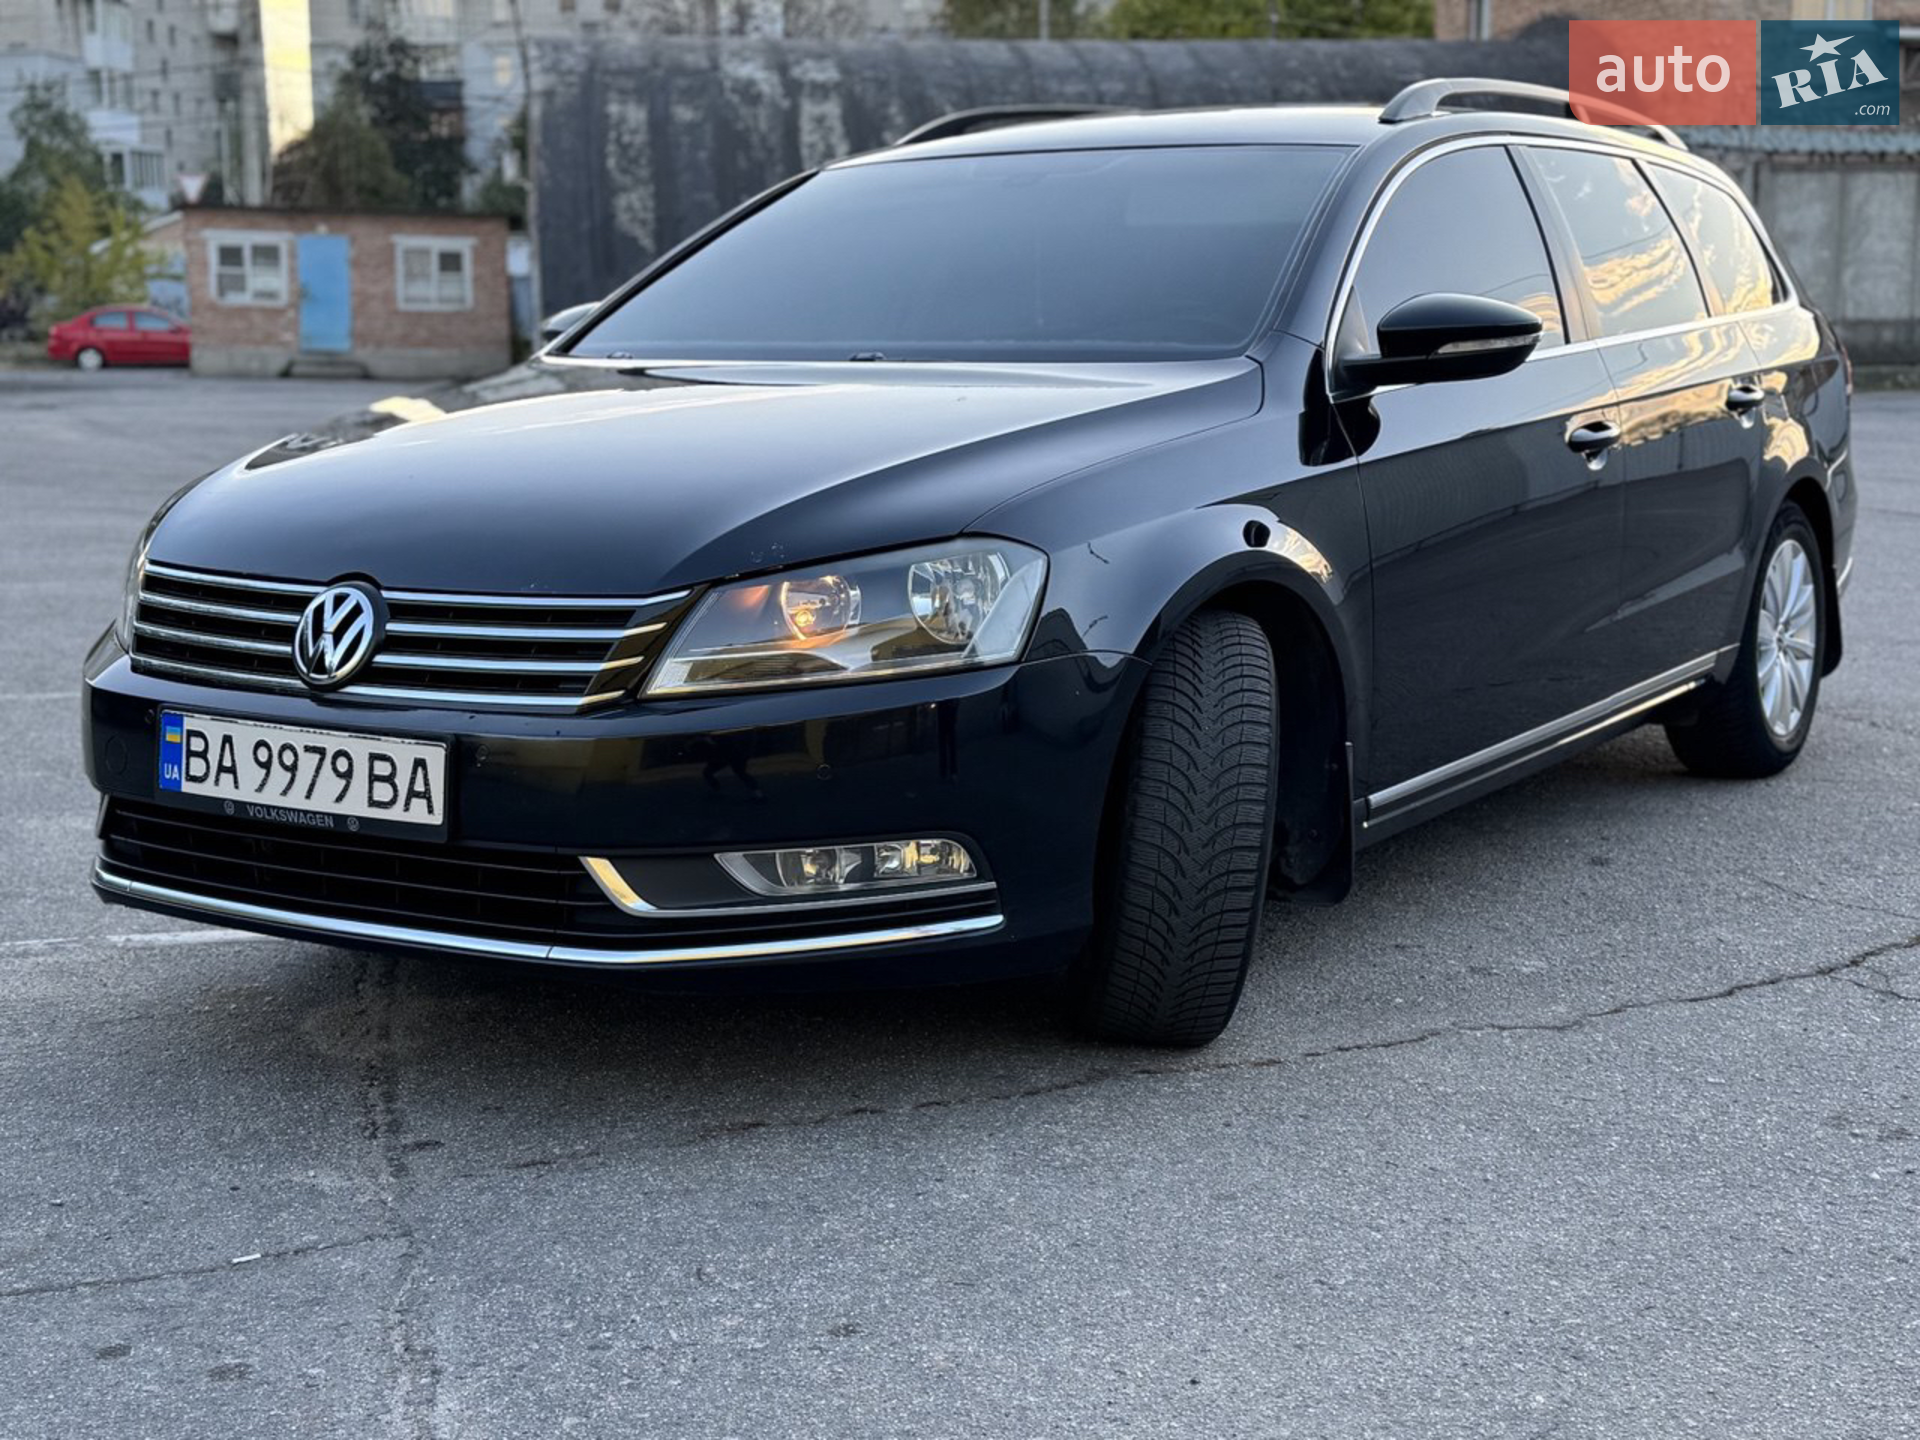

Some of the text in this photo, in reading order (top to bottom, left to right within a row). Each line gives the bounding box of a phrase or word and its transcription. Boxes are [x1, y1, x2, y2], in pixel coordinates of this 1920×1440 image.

[163, 762, 181, 782] UA
[184, 728, 435, 816] BA 9979 BA
[246, 804, 335, 829] VOLKSWAGEN
